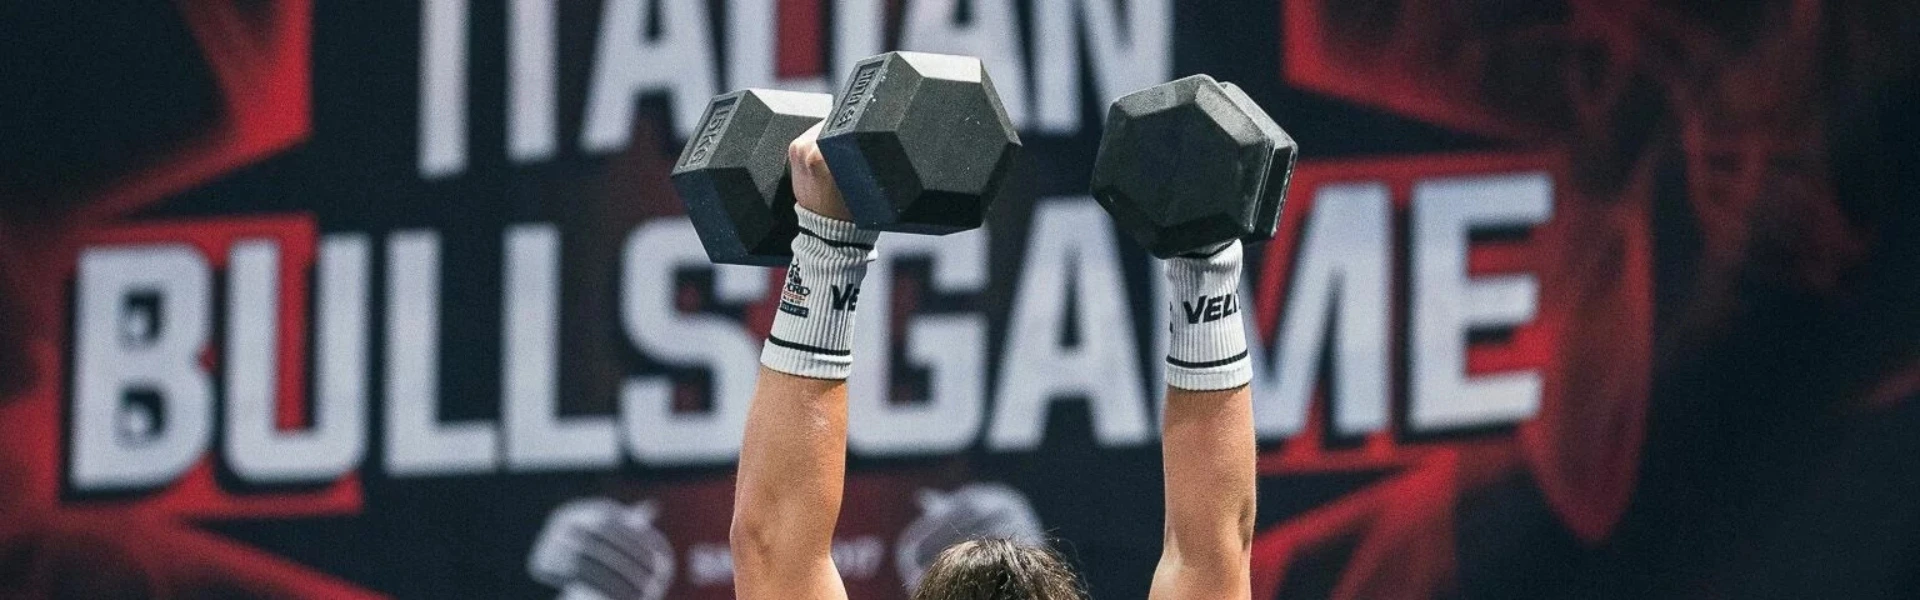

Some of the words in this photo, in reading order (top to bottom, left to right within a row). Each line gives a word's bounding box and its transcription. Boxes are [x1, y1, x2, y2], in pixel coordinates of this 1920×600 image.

[689, 106, 731, 164] 15KG
[69, 217, 770, 492] BULLS
[845, 171, 1556, 458] GAME
[1182, 290, 1240, 325] VELI
